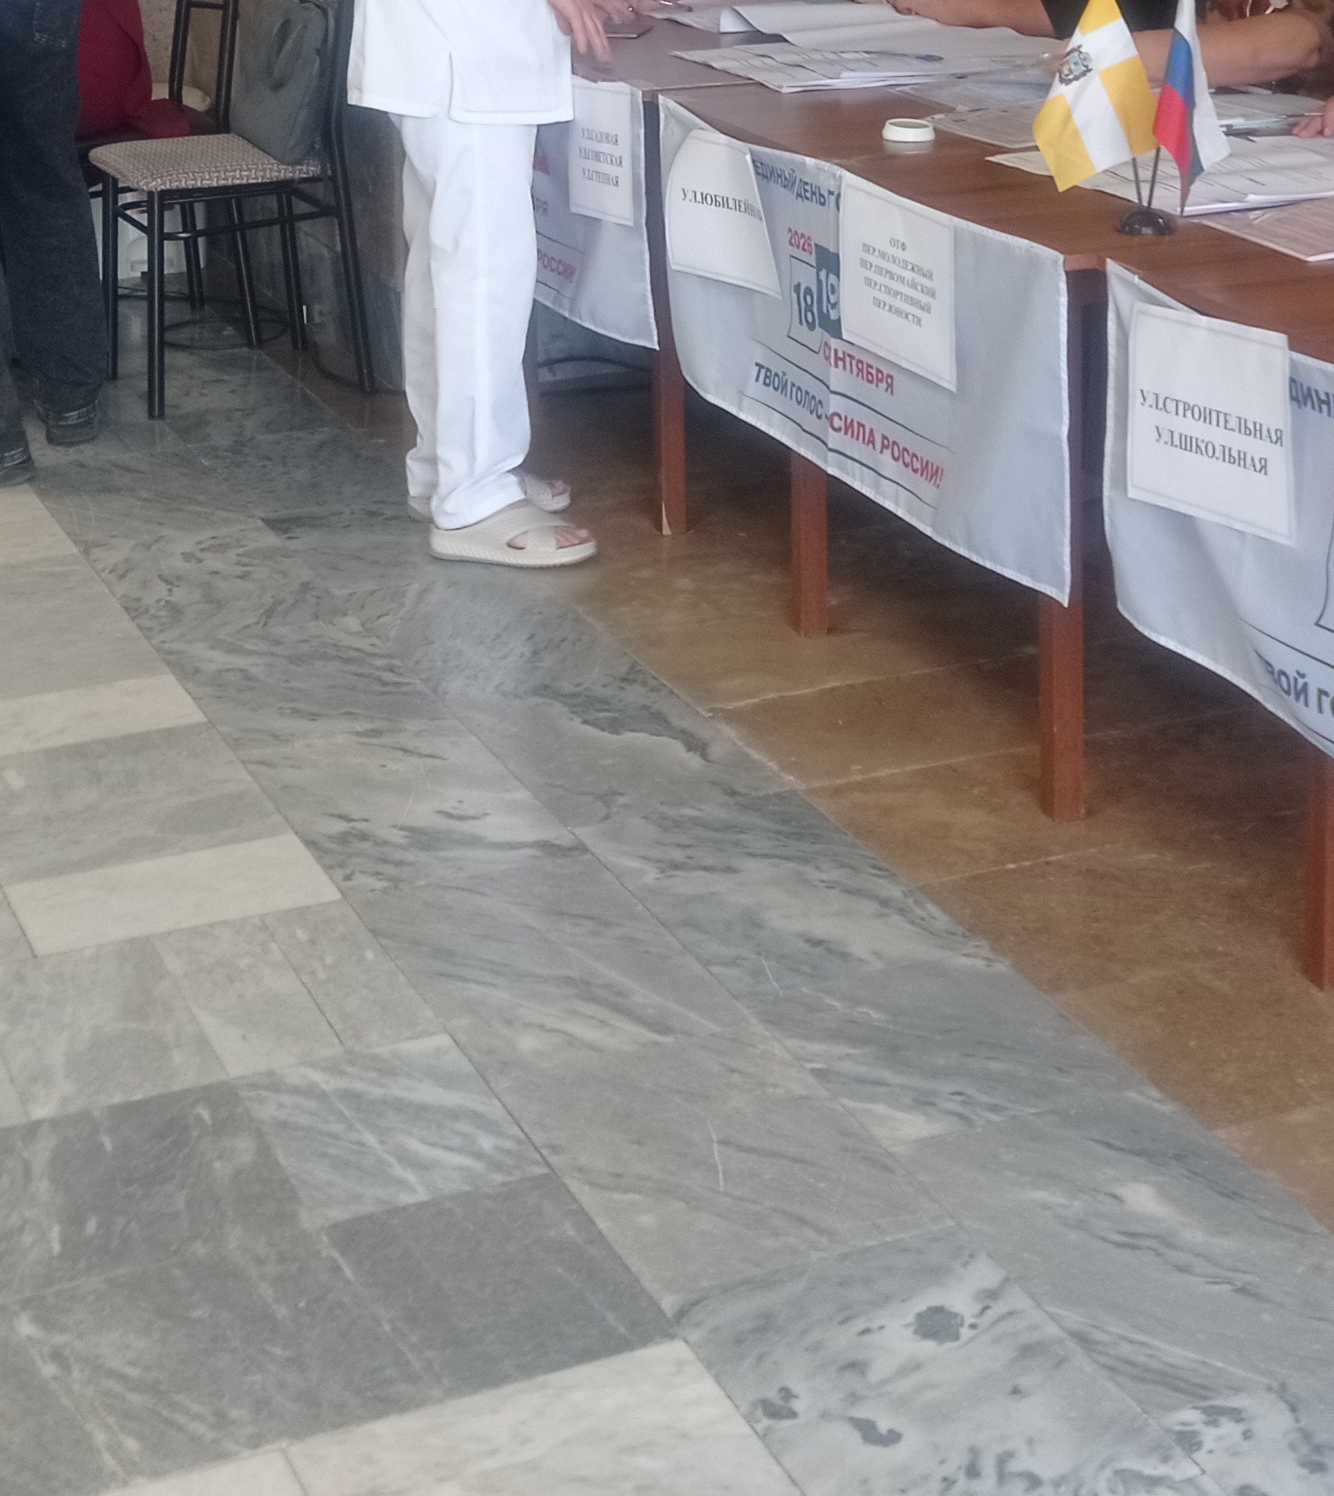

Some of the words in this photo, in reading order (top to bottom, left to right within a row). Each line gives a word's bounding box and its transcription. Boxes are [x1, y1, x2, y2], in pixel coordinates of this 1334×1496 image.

[796, 177, 827, 208] ДЕНЬ
[787, 227, 814, 255] 2026
[793, 281, 817, 332] 18
[818, 268, 840, 320] 19
[754, 361, 789, 396] ТВОЙ
[790, 381, 824, 420] ГОЛОС
[829, 411, 876, 451] СИЛА
[880, 433, 944, 490] РОССИИ!
[1139, 388, 1284, 448] УЛ.СТРОИТЕЛЬНАЯ
[1155, 425, 1269, 476] УЛ.ШКОЛЬНАЯ
